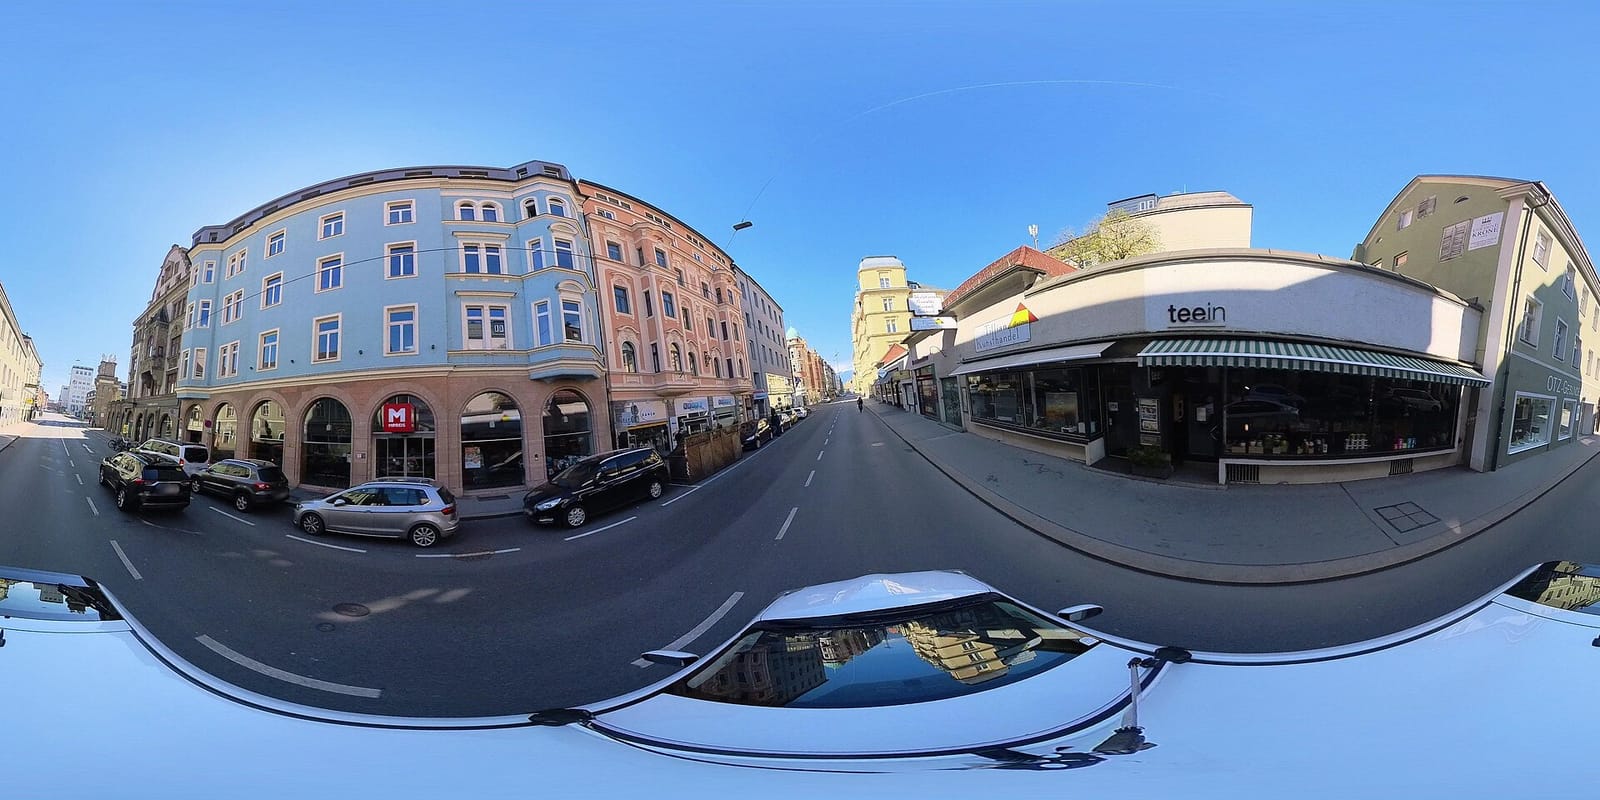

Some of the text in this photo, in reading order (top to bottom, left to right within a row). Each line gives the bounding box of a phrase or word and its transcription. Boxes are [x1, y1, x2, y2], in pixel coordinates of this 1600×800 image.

[1472, 227, 1498, 238] KRONE
[1168, 302, 1226, 322] teein
[389, 408, 405, 423] M
